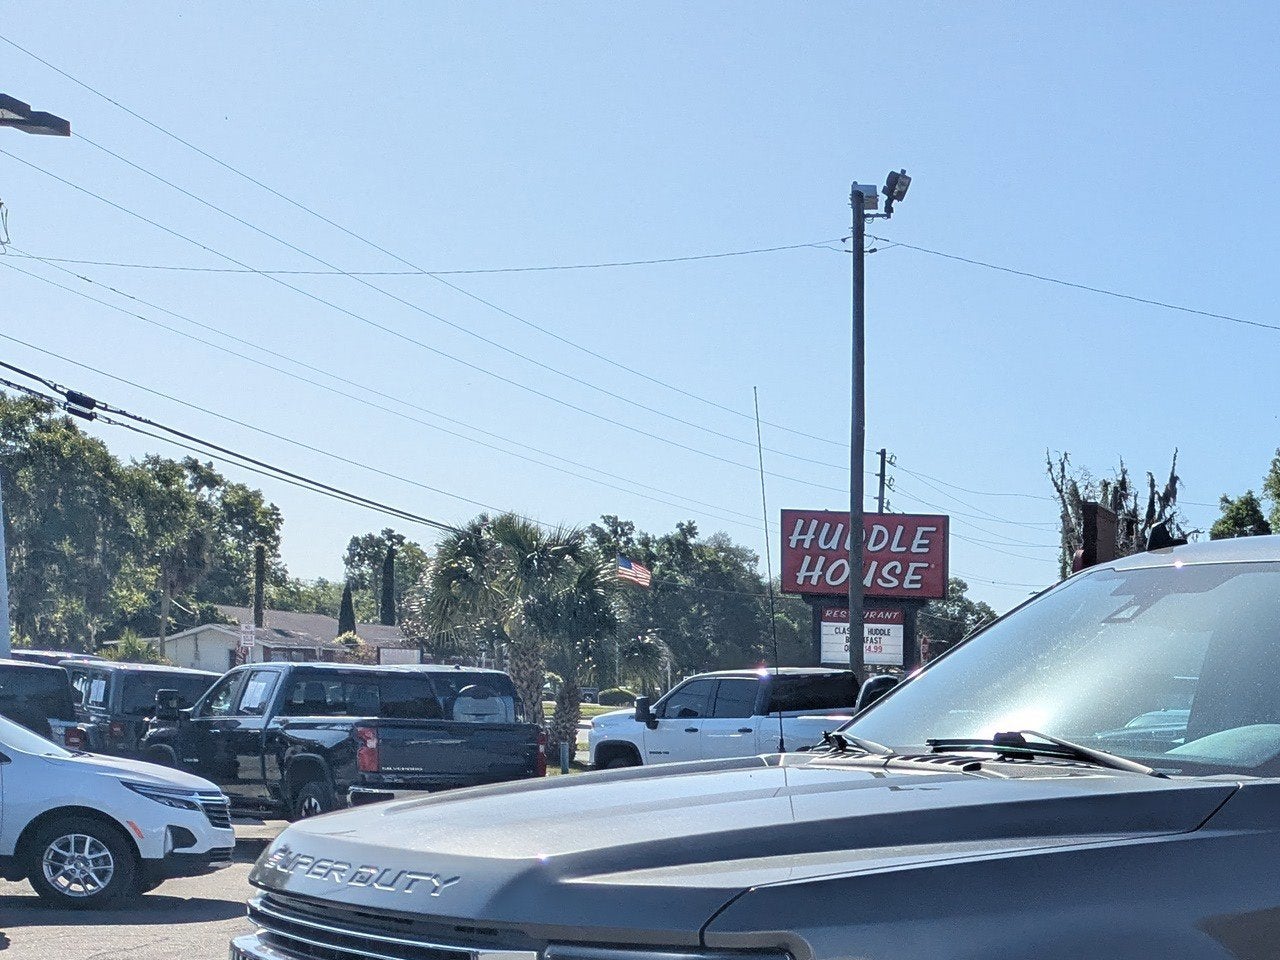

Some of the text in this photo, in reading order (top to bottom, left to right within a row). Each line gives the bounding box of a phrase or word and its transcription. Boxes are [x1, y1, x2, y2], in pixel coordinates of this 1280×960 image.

[788, 518, 936, 553] HUDLE
[867, 628, 891, 637] HUDDLE
[265, 846, 461, 897] SUPER DUTY
